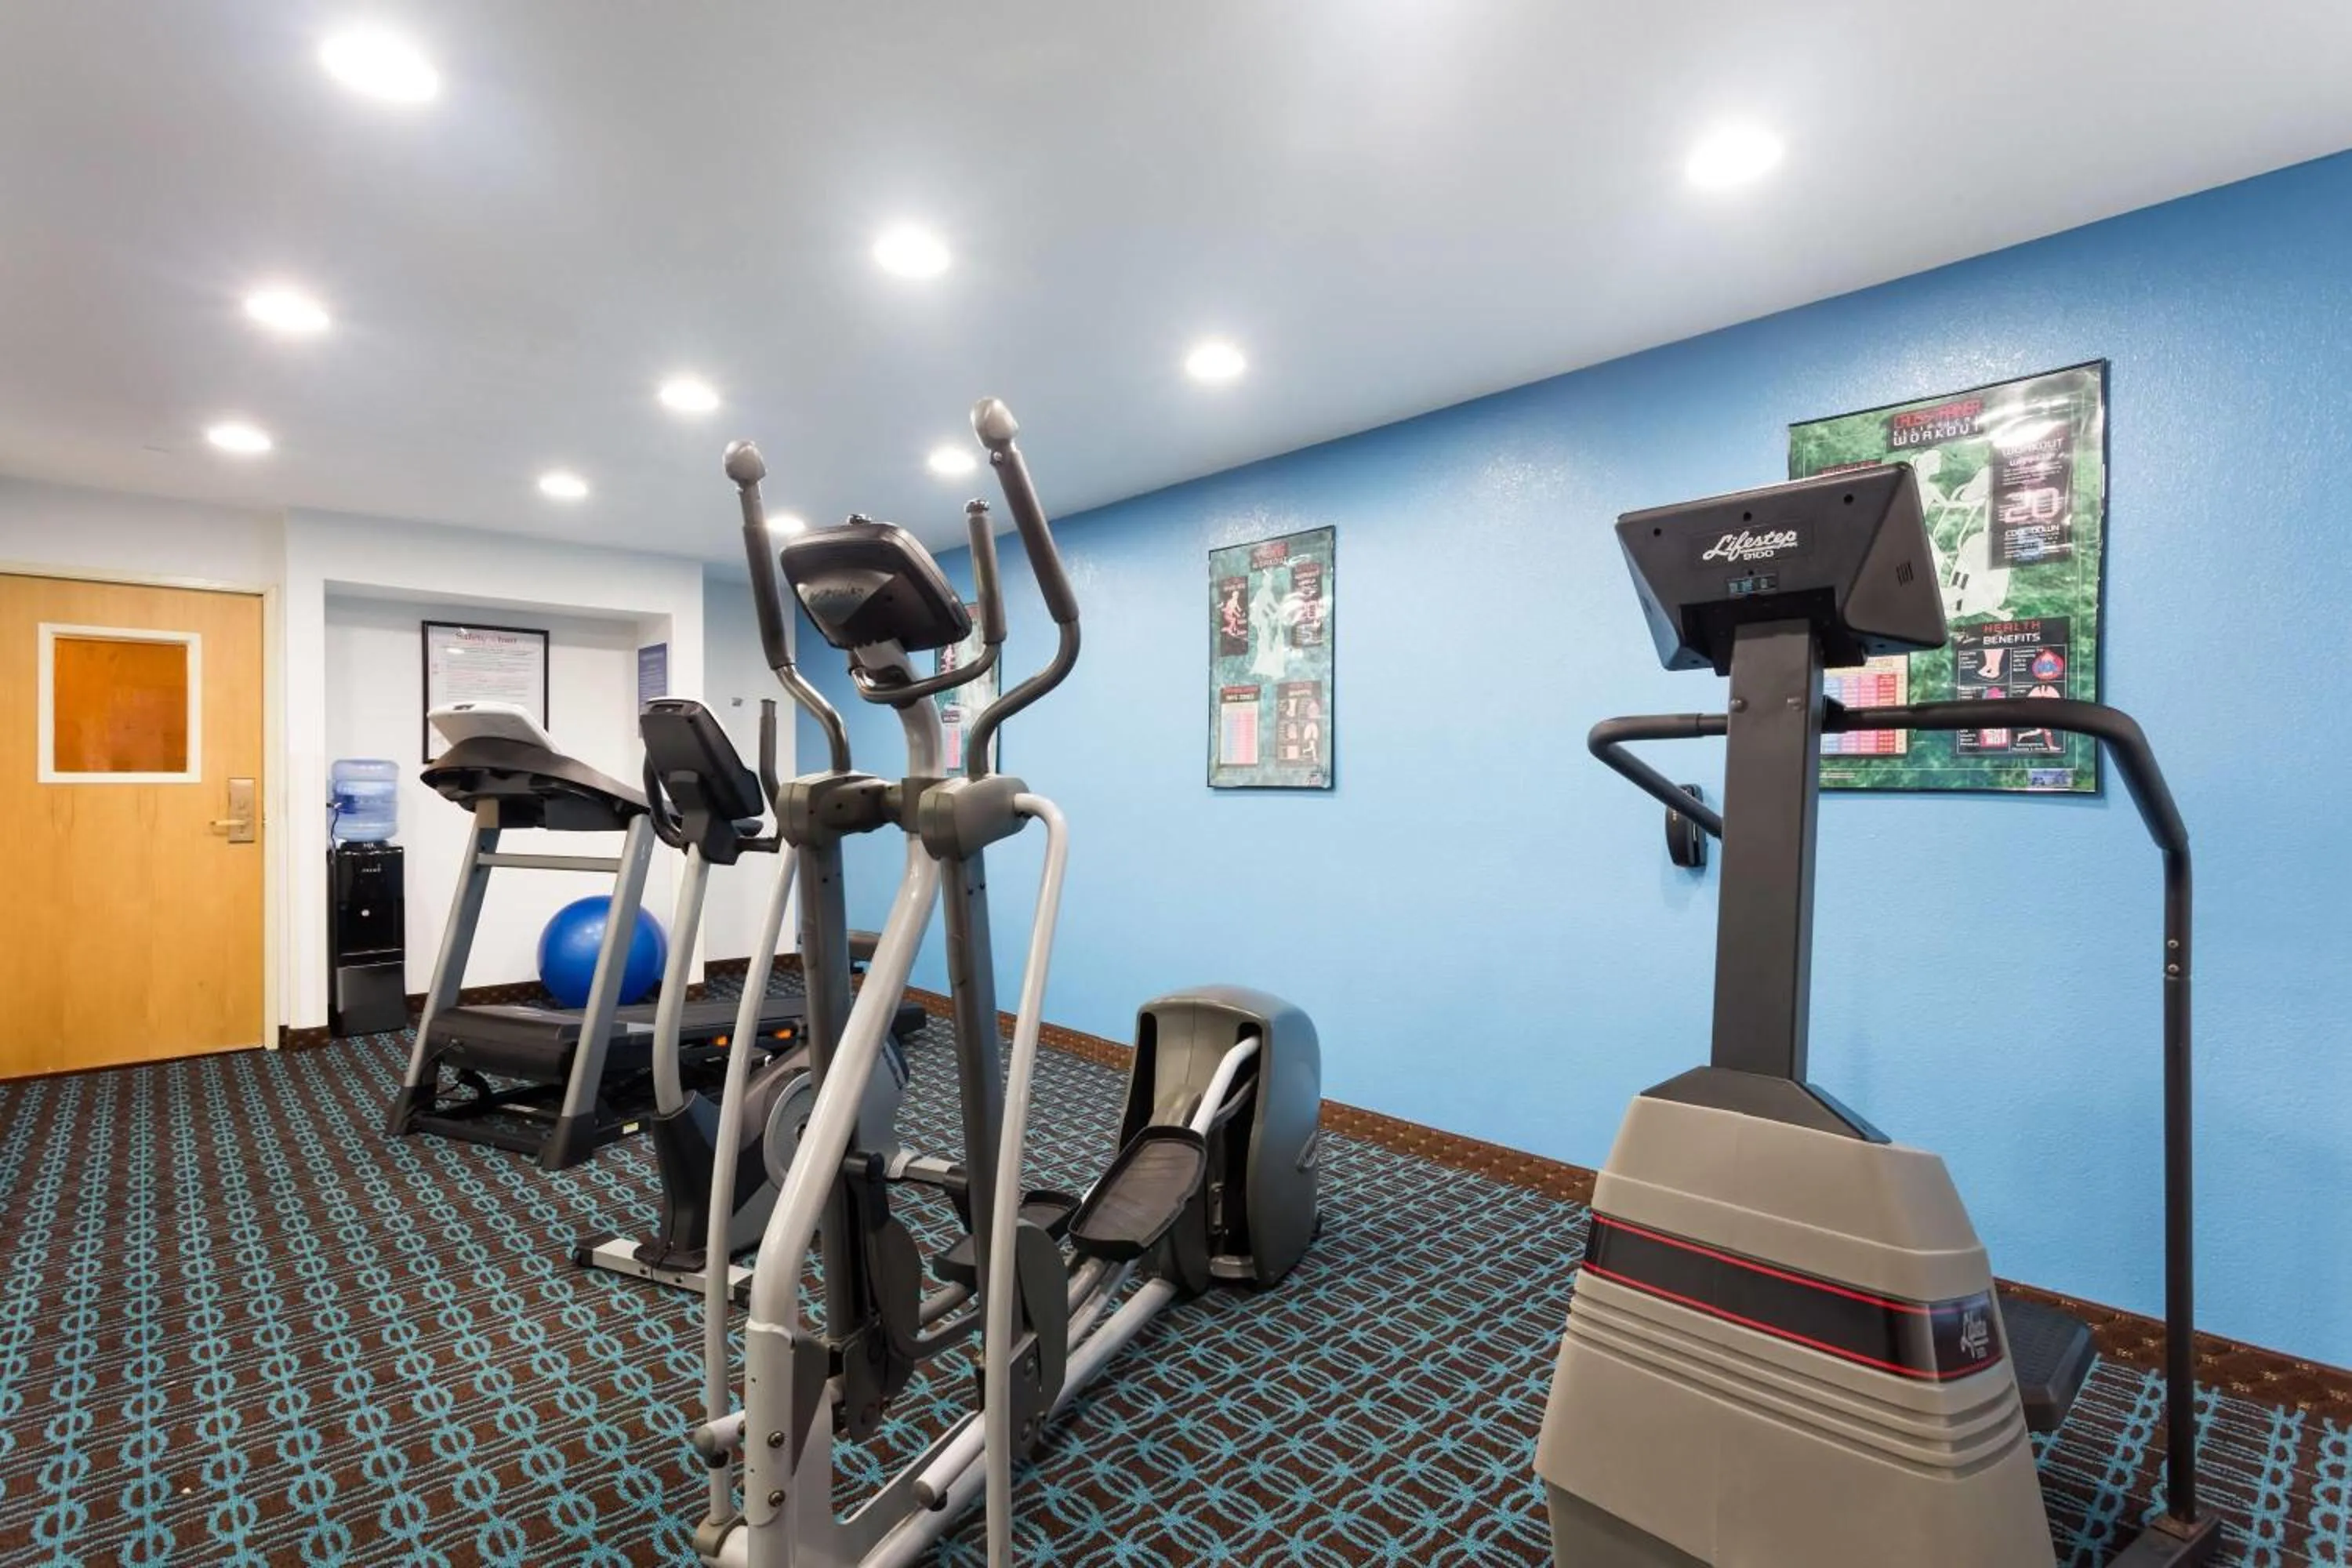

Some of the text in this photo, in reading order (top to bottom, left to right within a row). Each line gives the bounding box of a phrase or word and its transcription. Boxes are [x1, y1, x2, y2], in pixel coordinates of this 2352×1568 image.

[1893, 421, 1980, 446] WORKOUT
[1702, 531, 1798, 561] Lifestep
[1983, 620, 2041, 633] HEALTH
[1983, 632, 2041, 644] BENEFITS
